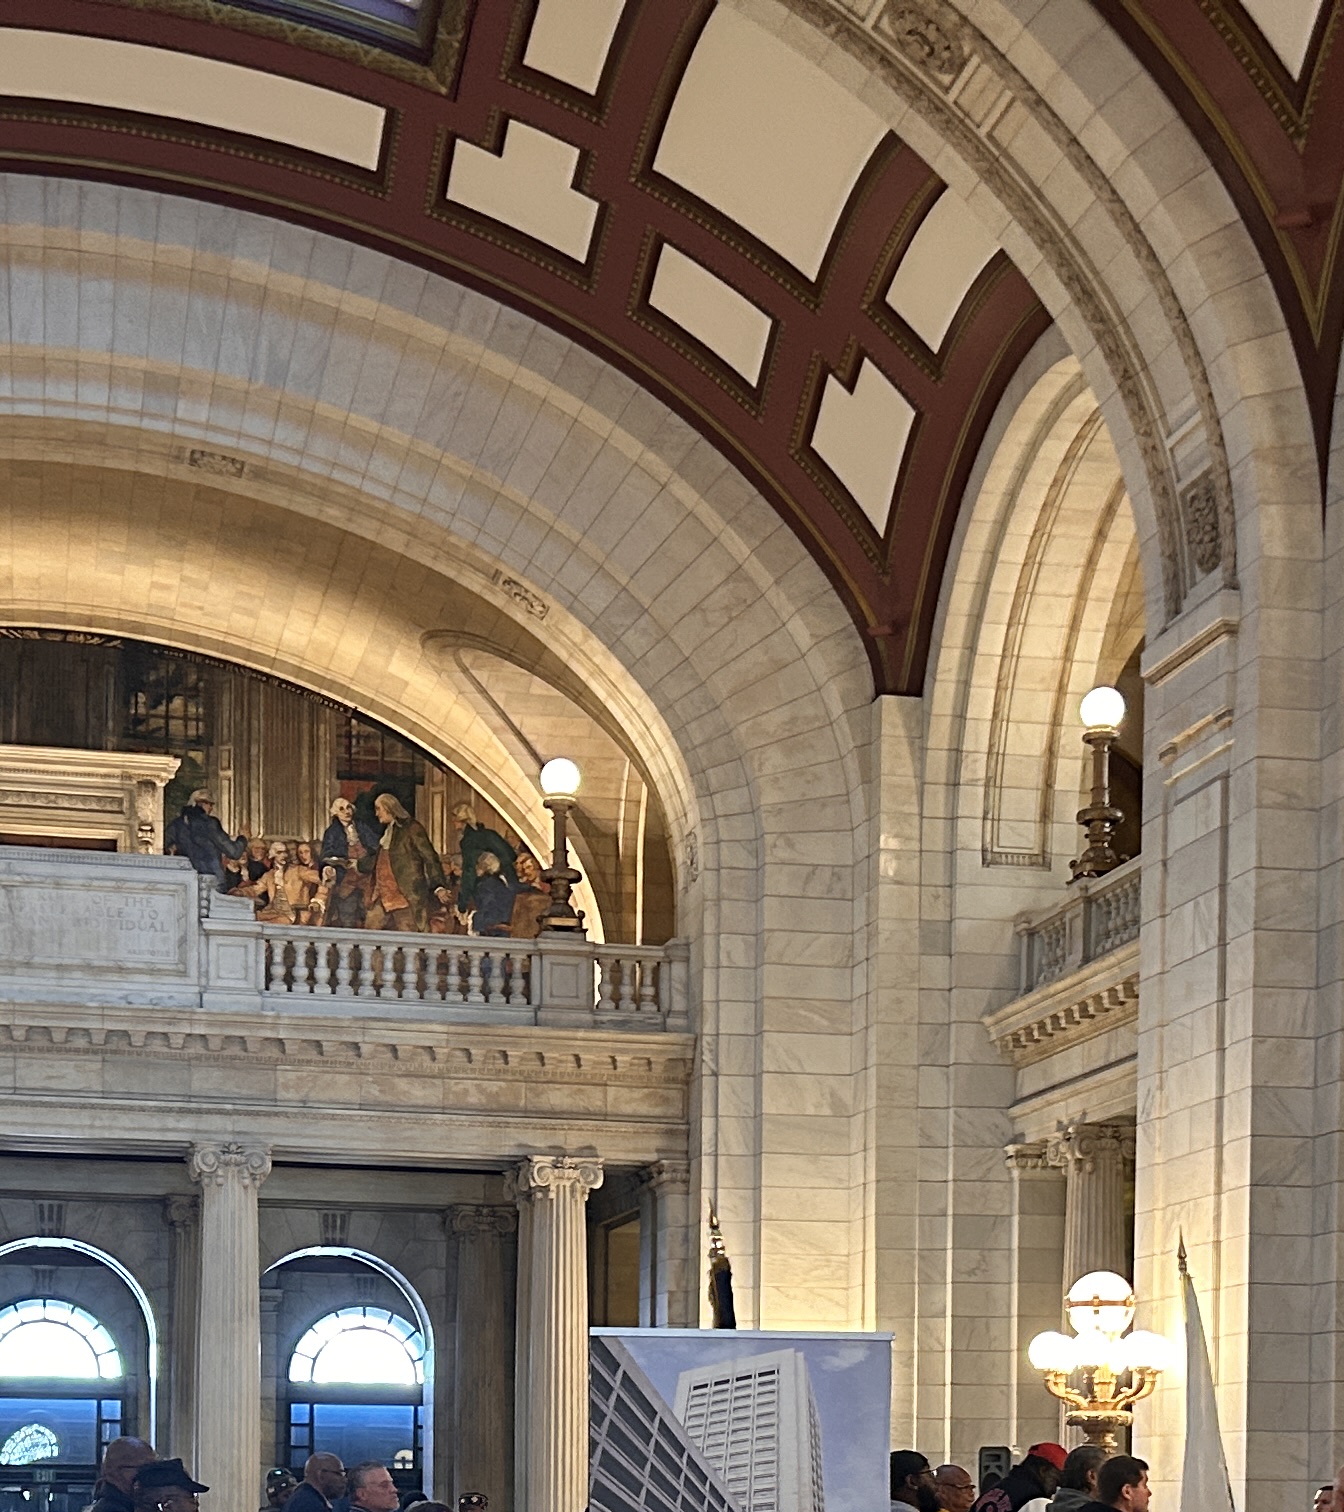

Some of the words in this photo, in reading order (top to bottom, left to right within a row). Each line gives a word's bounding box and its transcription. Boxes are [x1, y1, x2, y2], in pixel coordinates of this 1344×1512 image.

[91, 894, 113, 905] OF
[123, 896, 155, 908] THE
[137, 909, 160, 921] TO
